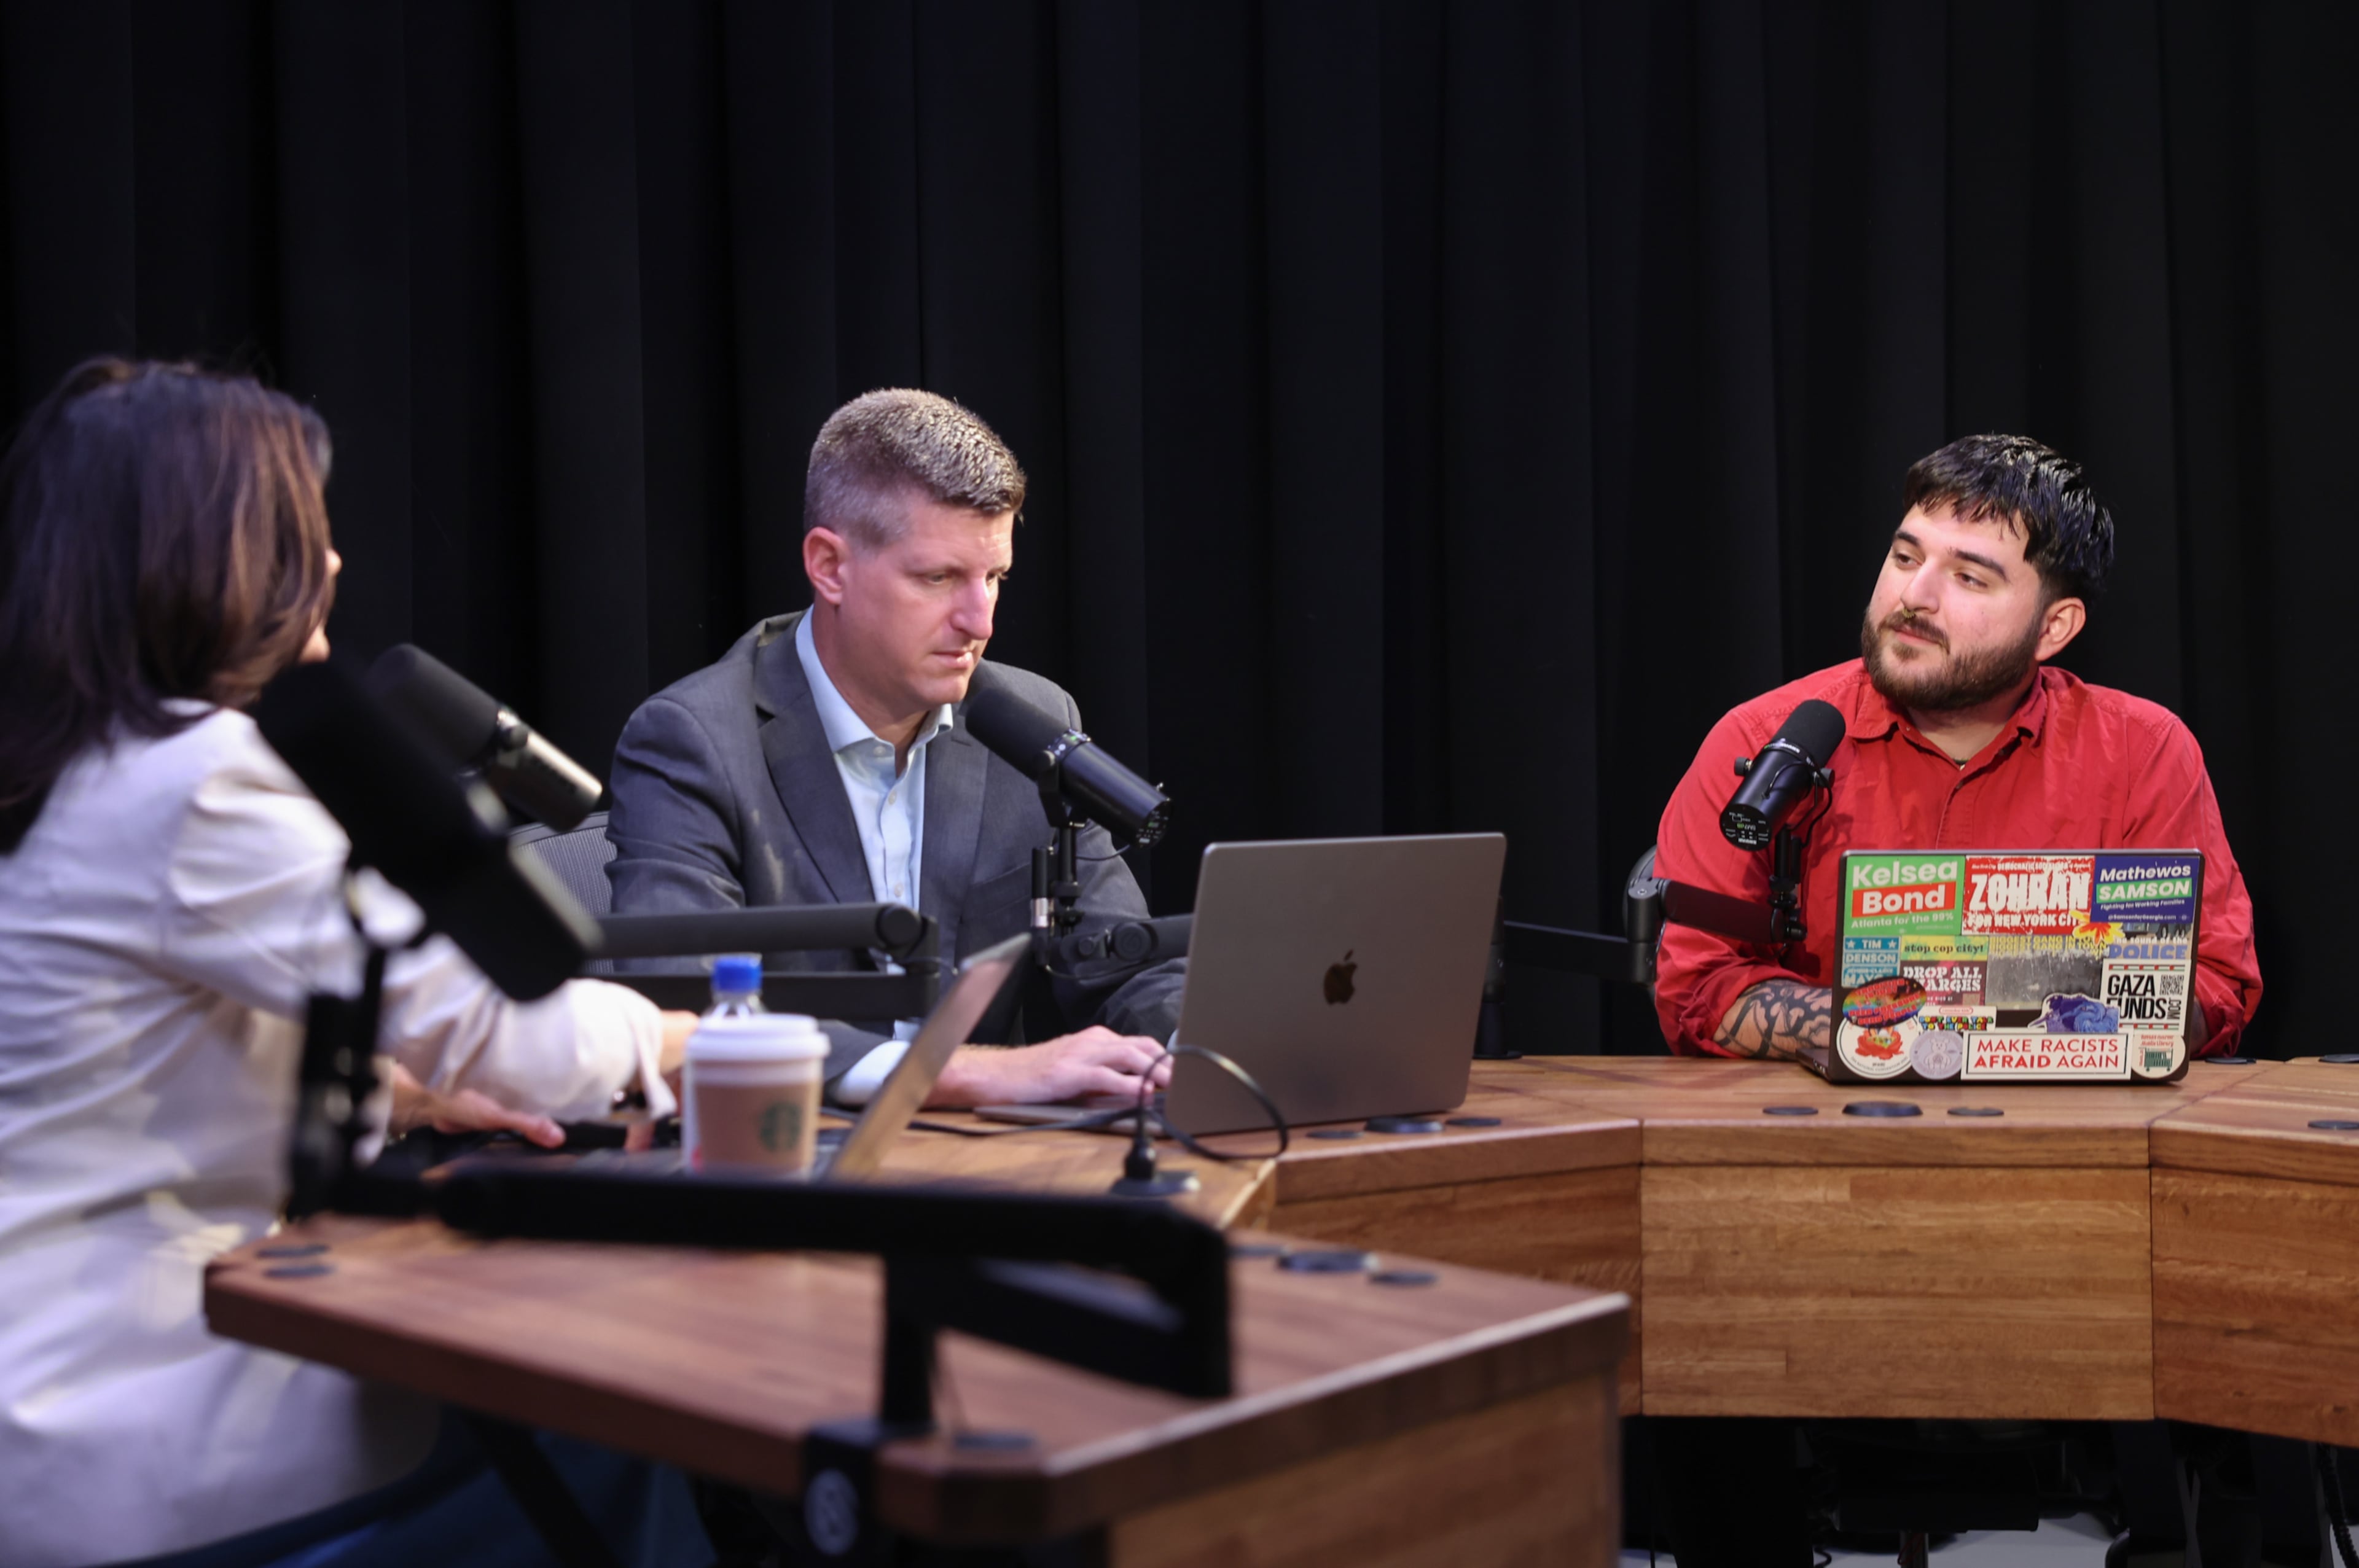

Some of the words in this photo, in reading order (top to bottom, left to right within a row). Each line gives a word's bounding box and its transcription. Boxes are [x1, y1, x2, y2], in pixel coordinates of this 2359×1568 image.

[1852, 861, 1958, 888] Kelsea
[2100, 865, 2191, 883] Mathewos
[1969, 873, 2091, 911] ZOHRAN
[2099, 881, 2190, 901] SAMSON
[1862, 884, 1946, 915] Bond
[1852, 918, 1892, 929] Atlanta
[1895, 916, 1909, 925] for
[1912, 915, 1930, 924] the
[1932, 912, 1954, 922] 99%
[1968, 913, 1992, 927] FOR
[1994, 913, 2022, 928] NEW
[2024, 913, 2057, 927] YORK
[2058, 912, 2080, 927] CIT
[1862, 939, 1882, 949] TIM
[1904, 944, 1931, 954] stop
[1956, 943, 1984, 954] city!
[2108, 944, 2188, 959] POLICE
[1845, 953, 1896, 964] DENSON
[1845, 973, 1884, 985] MAY
[1903, 966, 1948, 979] DROP
[1950, 966, 1982, 979] ALL
[1918, 978, 1981, 993] ARGES
[2107, 974, 2156, 997] GAZA
[1922, 1022, 1936, 1031] TO
[1937, 1022, 1955, 1031] THE
[1957, 1022, 1987, 1031] POLICE
[1976, 1039, 2032, 1053] MAKE
[2041, 1039, 2118, 1053] RACISTS
[1974, 1055, 2051, 1069] AFRAID
[2056, 1055, 2119, 1069] AGAIN
